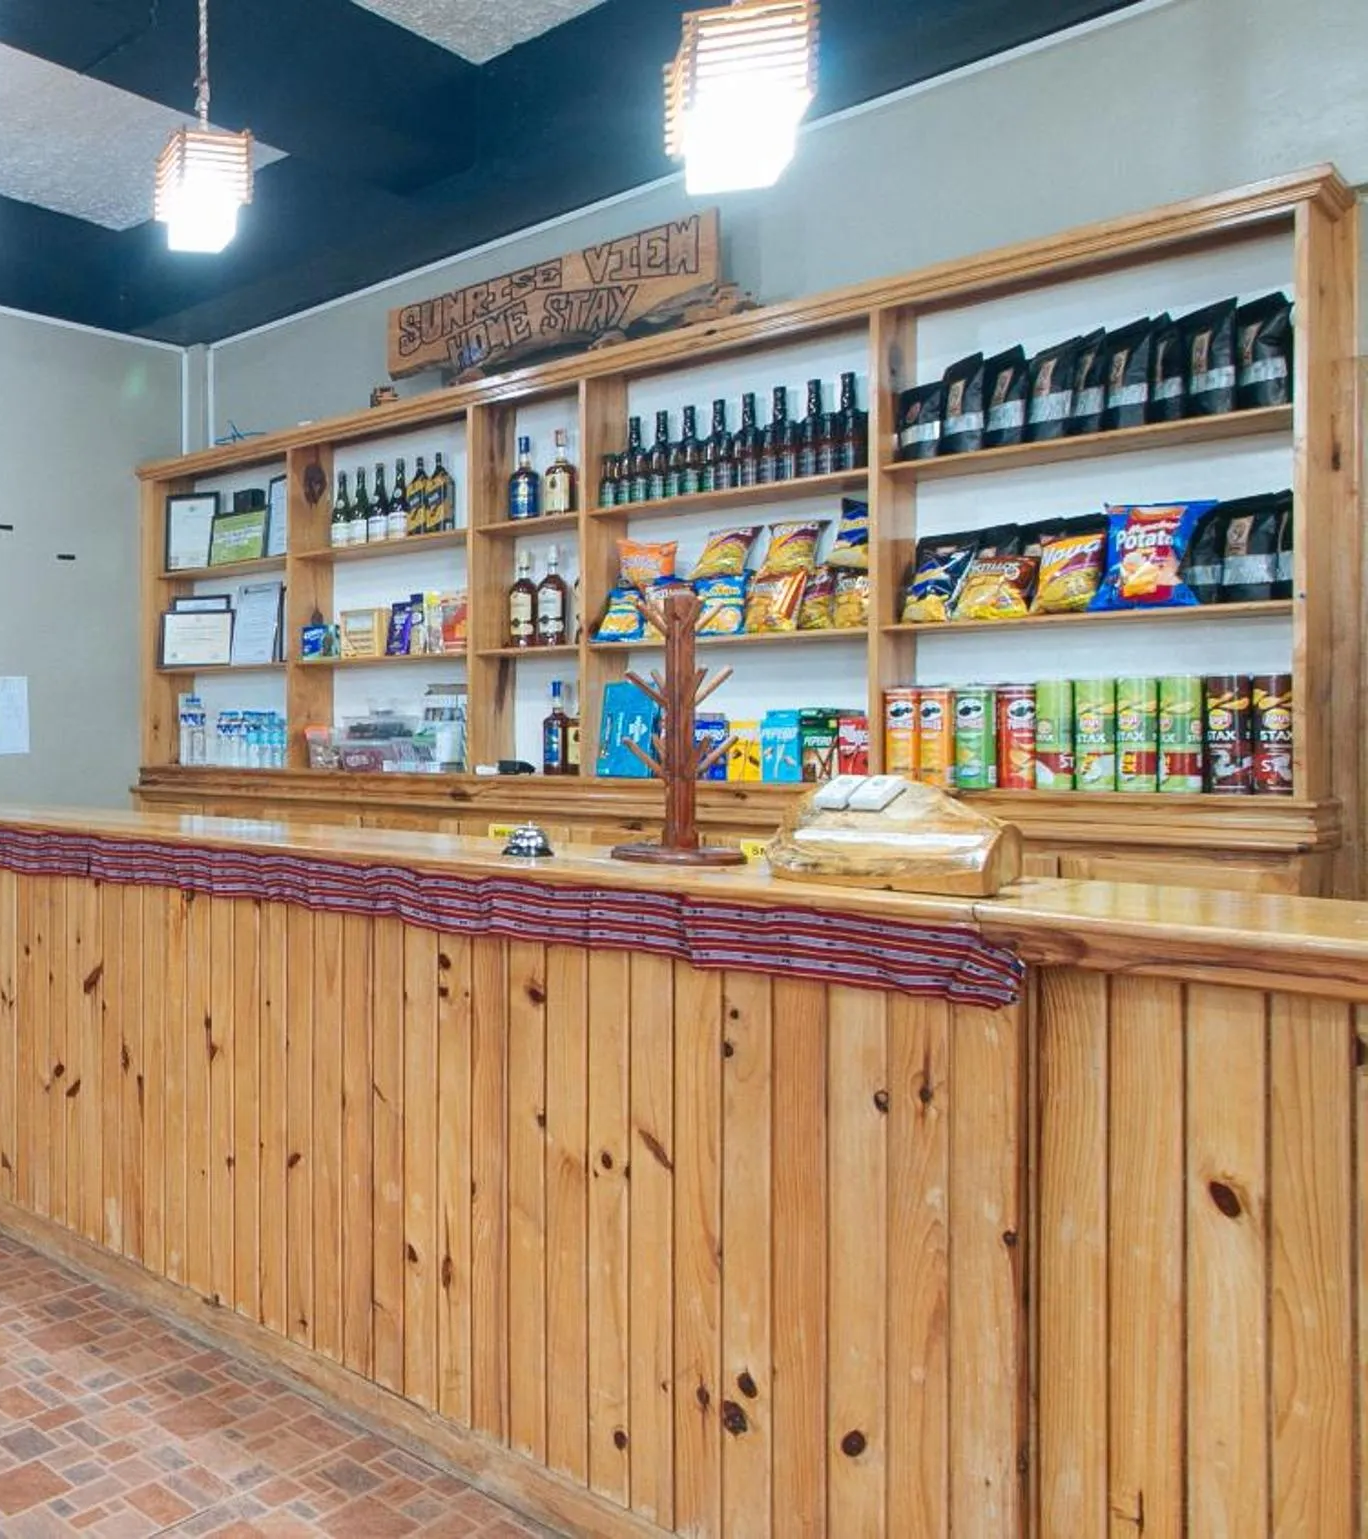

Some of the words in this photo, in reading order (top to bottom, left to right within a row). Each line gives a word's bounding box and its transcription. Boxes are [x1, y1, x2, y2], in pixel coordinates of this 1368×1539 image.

[398, 258, 563, 356] SUNRISE
[583, 214, 700, 285] VIEW
[445, 303, 532, 371] HOME
[539, 285, 639, 343] STAY
